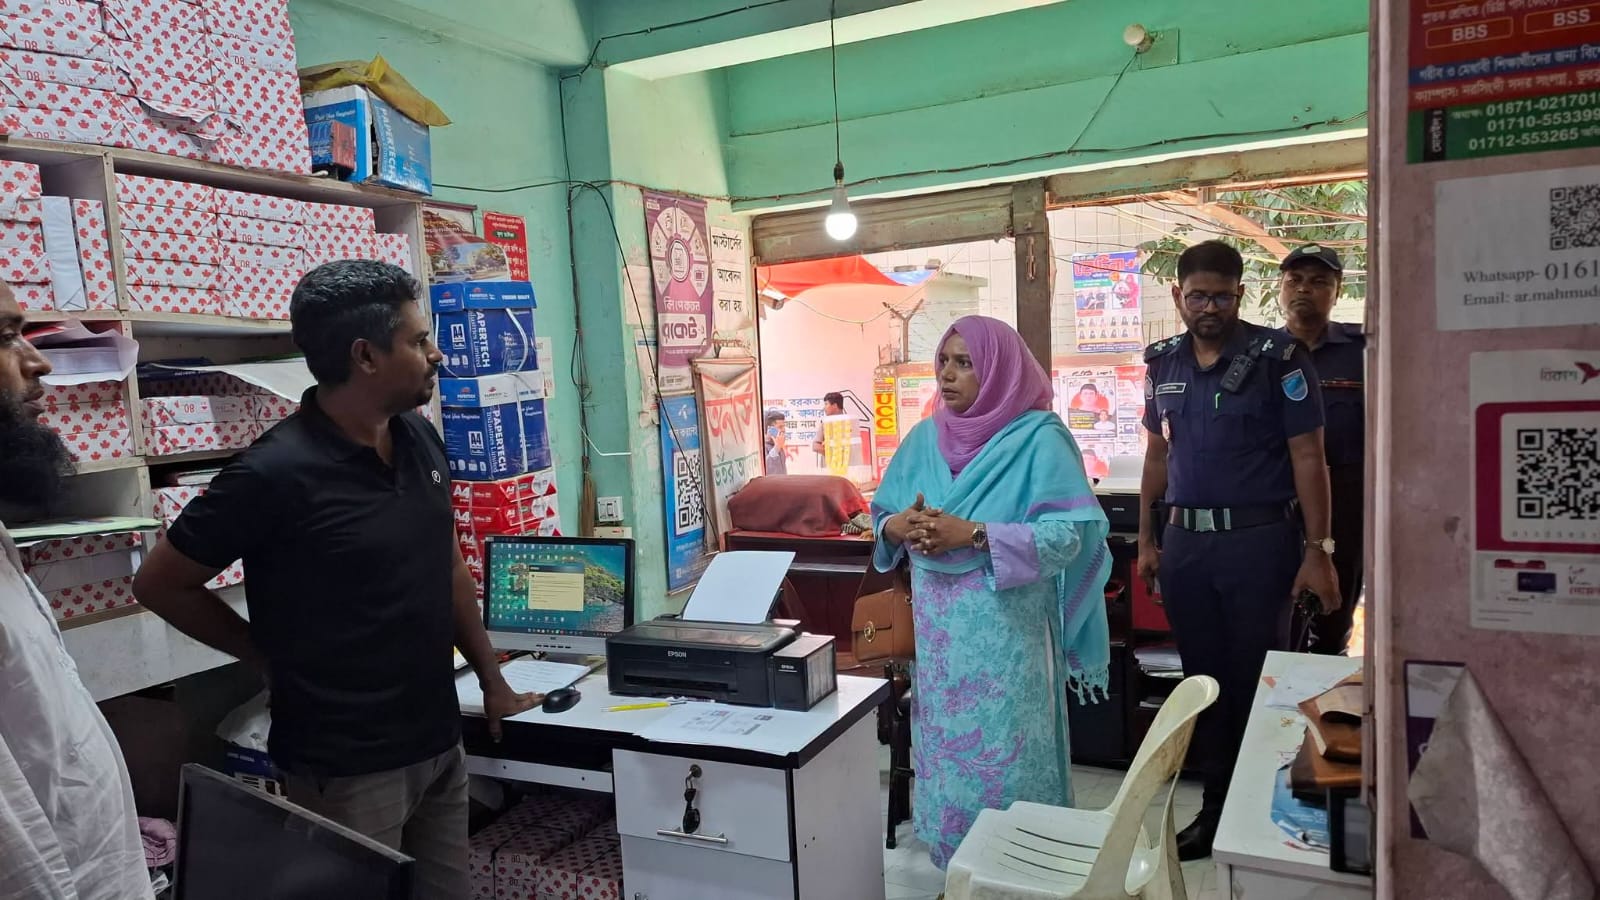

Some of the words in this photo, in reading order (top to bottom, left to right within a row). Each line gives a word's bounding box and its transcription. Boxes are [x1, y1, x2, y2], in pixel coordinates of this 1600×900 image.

[1552, 8, 1591, 27] BSS
[1452, 24, 1488, 42] BBS
[1486, 91, 1600, 116] 01871-021701
[1488, 109, 1600, 133] 01710-553399
[1469, 127, 1578, 150] 01712-553265
[1514, 284, 1600, 303] ar.mahmud
[476, 310, 492, 368] APERTECH
[470, 432, 481, 445] A4
[493, 408, 507, 472] PAPERTECH
[453, 484, 471, 499] A4
[454, 508, 471, 523] A4
[460, 532, 477, 546] A4
[667, 650, 687, 660] EPSON
